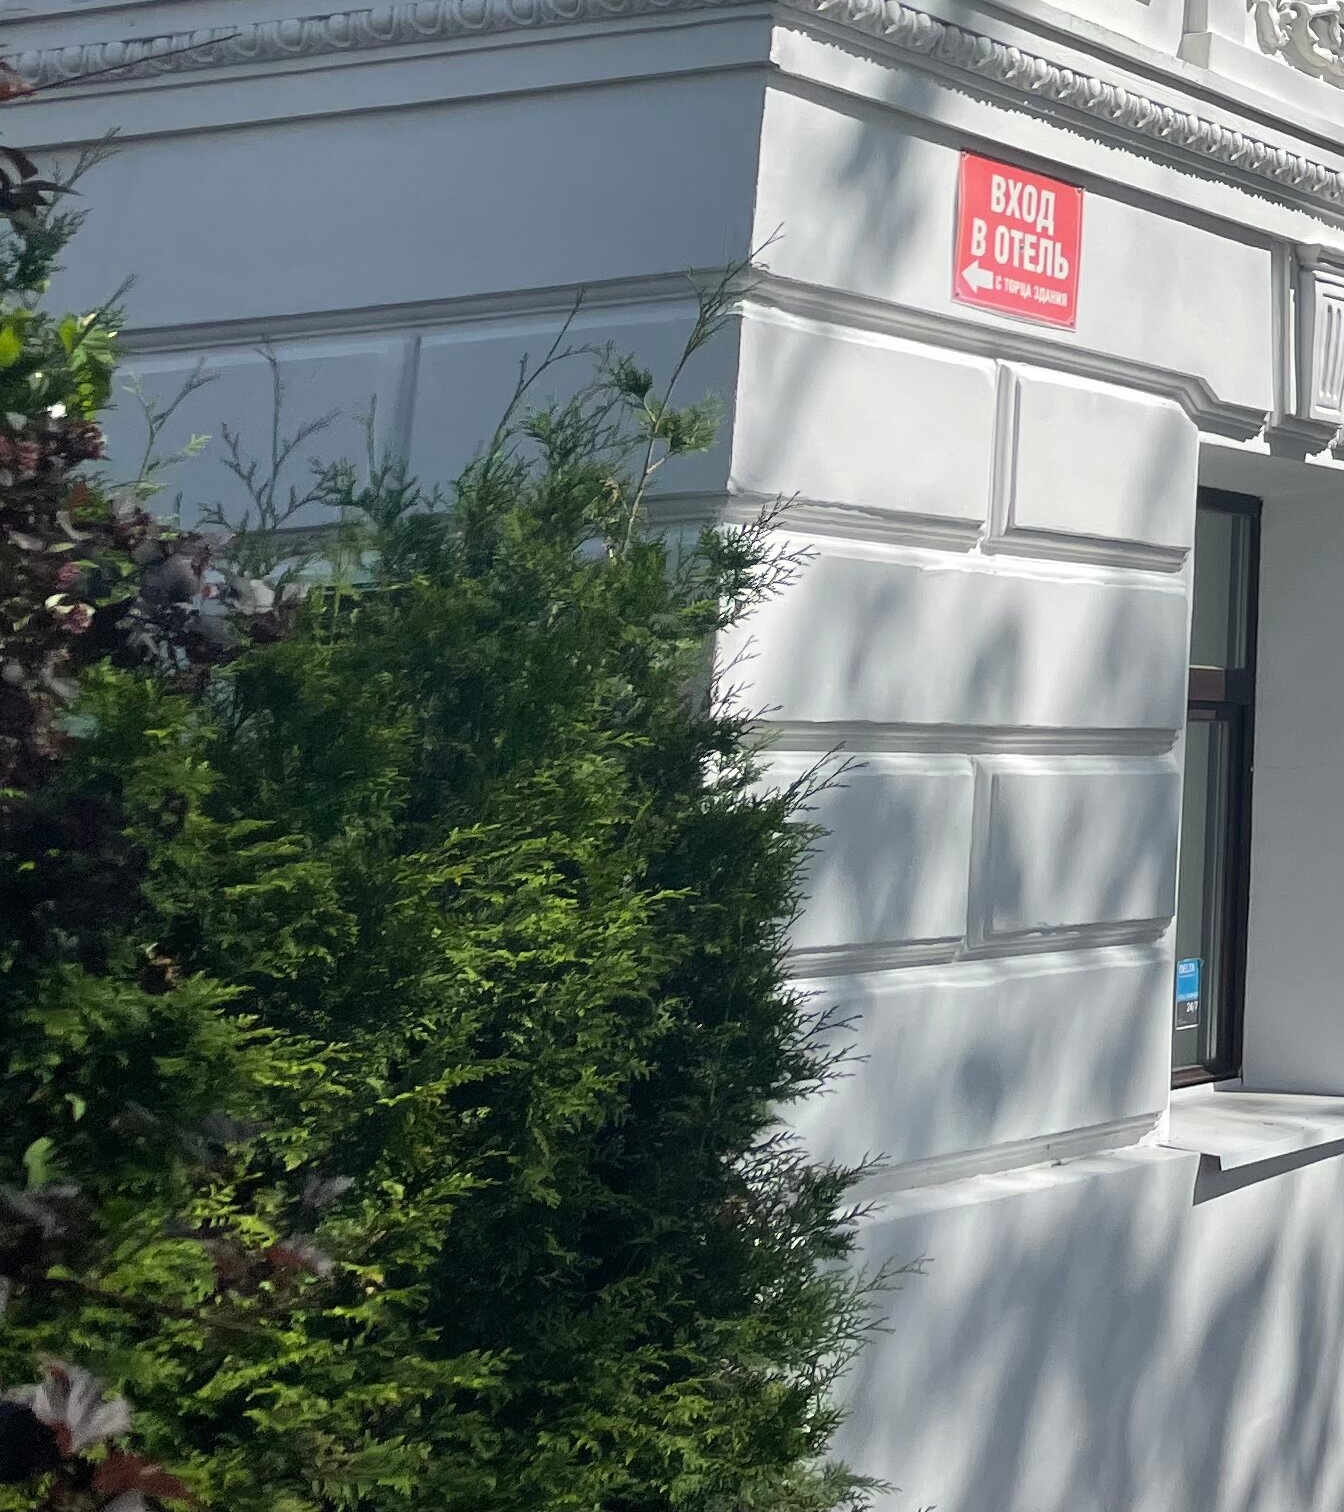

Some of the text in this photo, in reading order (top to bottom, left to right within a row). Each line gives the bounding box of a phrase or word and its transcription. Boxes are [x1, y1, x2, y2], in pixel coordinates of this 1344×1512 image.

[991, 175, 1055, 235] ВХОД
[971, 217, 1069, 280] В ОТЕЛЬ
[995, 275, 1068, 307] С ТОРЦА ЗДАНИЯ
